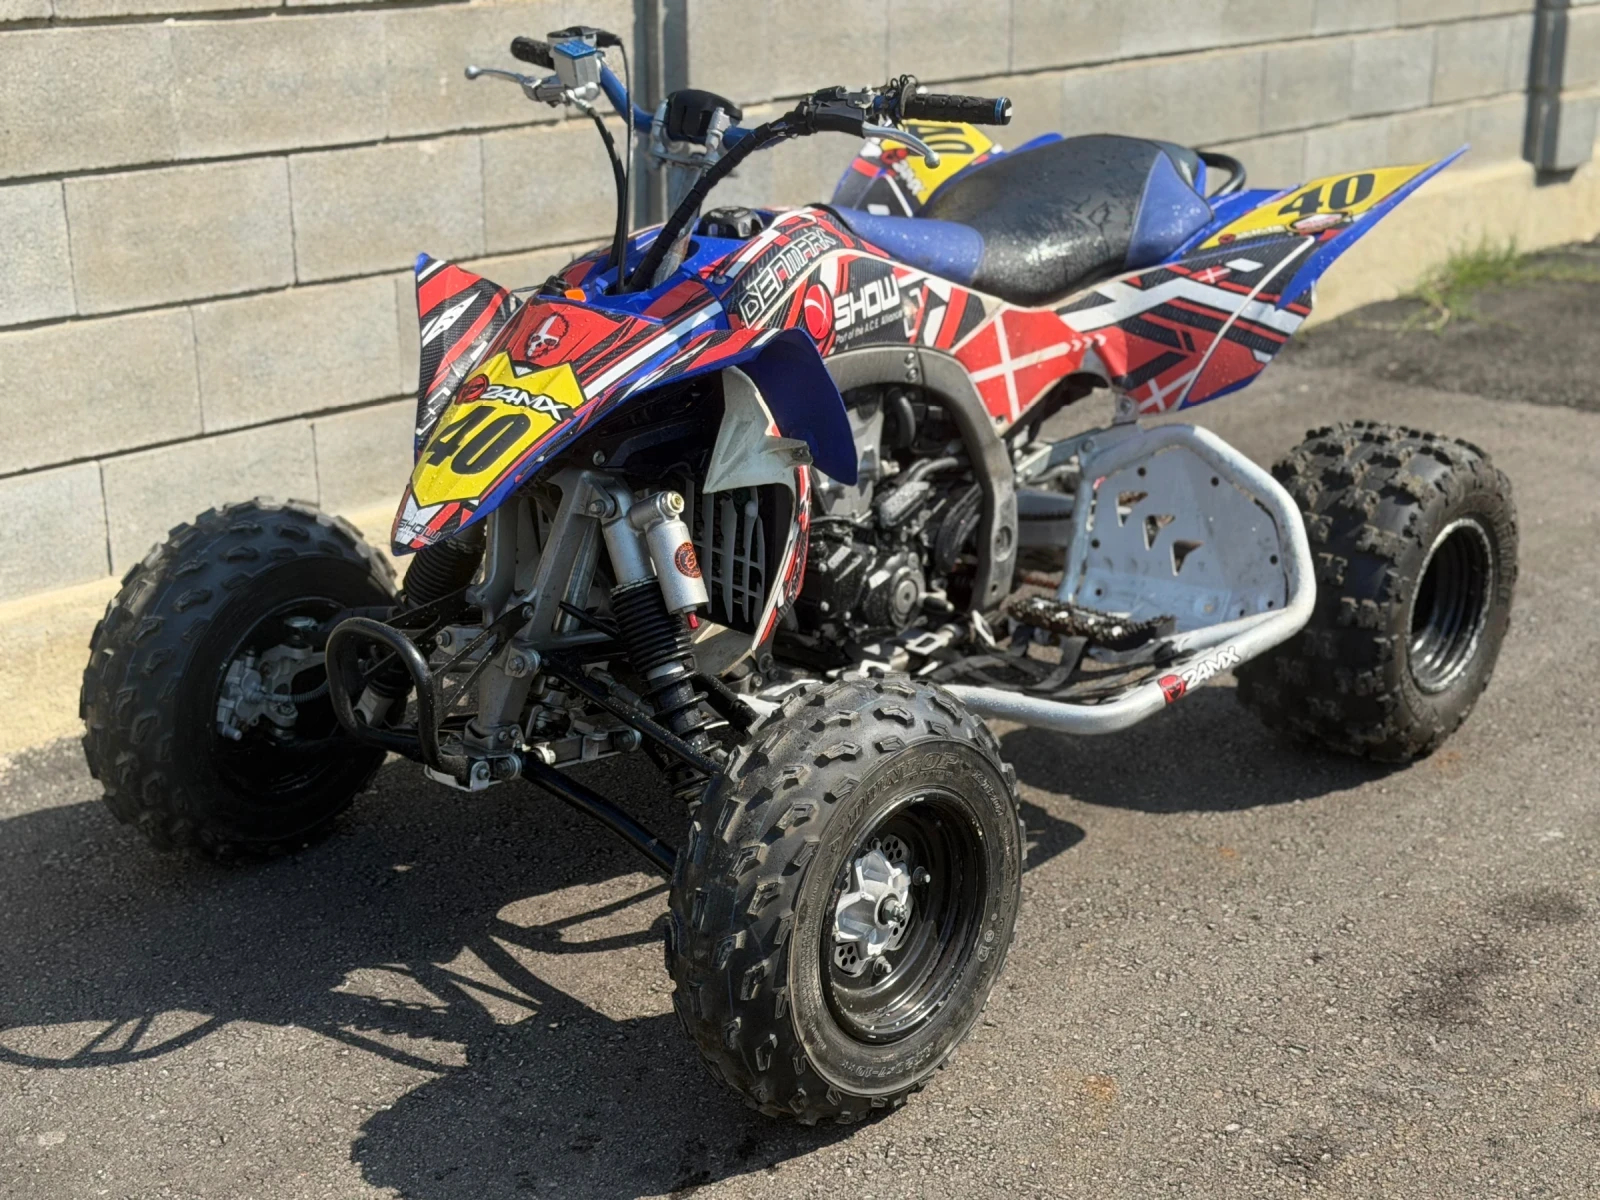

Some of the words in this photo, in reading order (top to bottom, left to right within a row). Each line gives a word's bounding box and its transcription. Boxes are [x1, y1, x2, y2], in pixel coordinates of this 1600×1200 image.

[1277, 173, 1375, 217] 40
[739, 229, 837, 330] DENMARK
[833, 273, 901, 331] SHOW
[480, 385, 569, 421] 24MX
[426, 405, 531, 475] 40
[397, 517, 442, 544] SHOW
[1182, 645, 1241, 691] 24MX
[849, 752, 960, 827] DUNLOP
